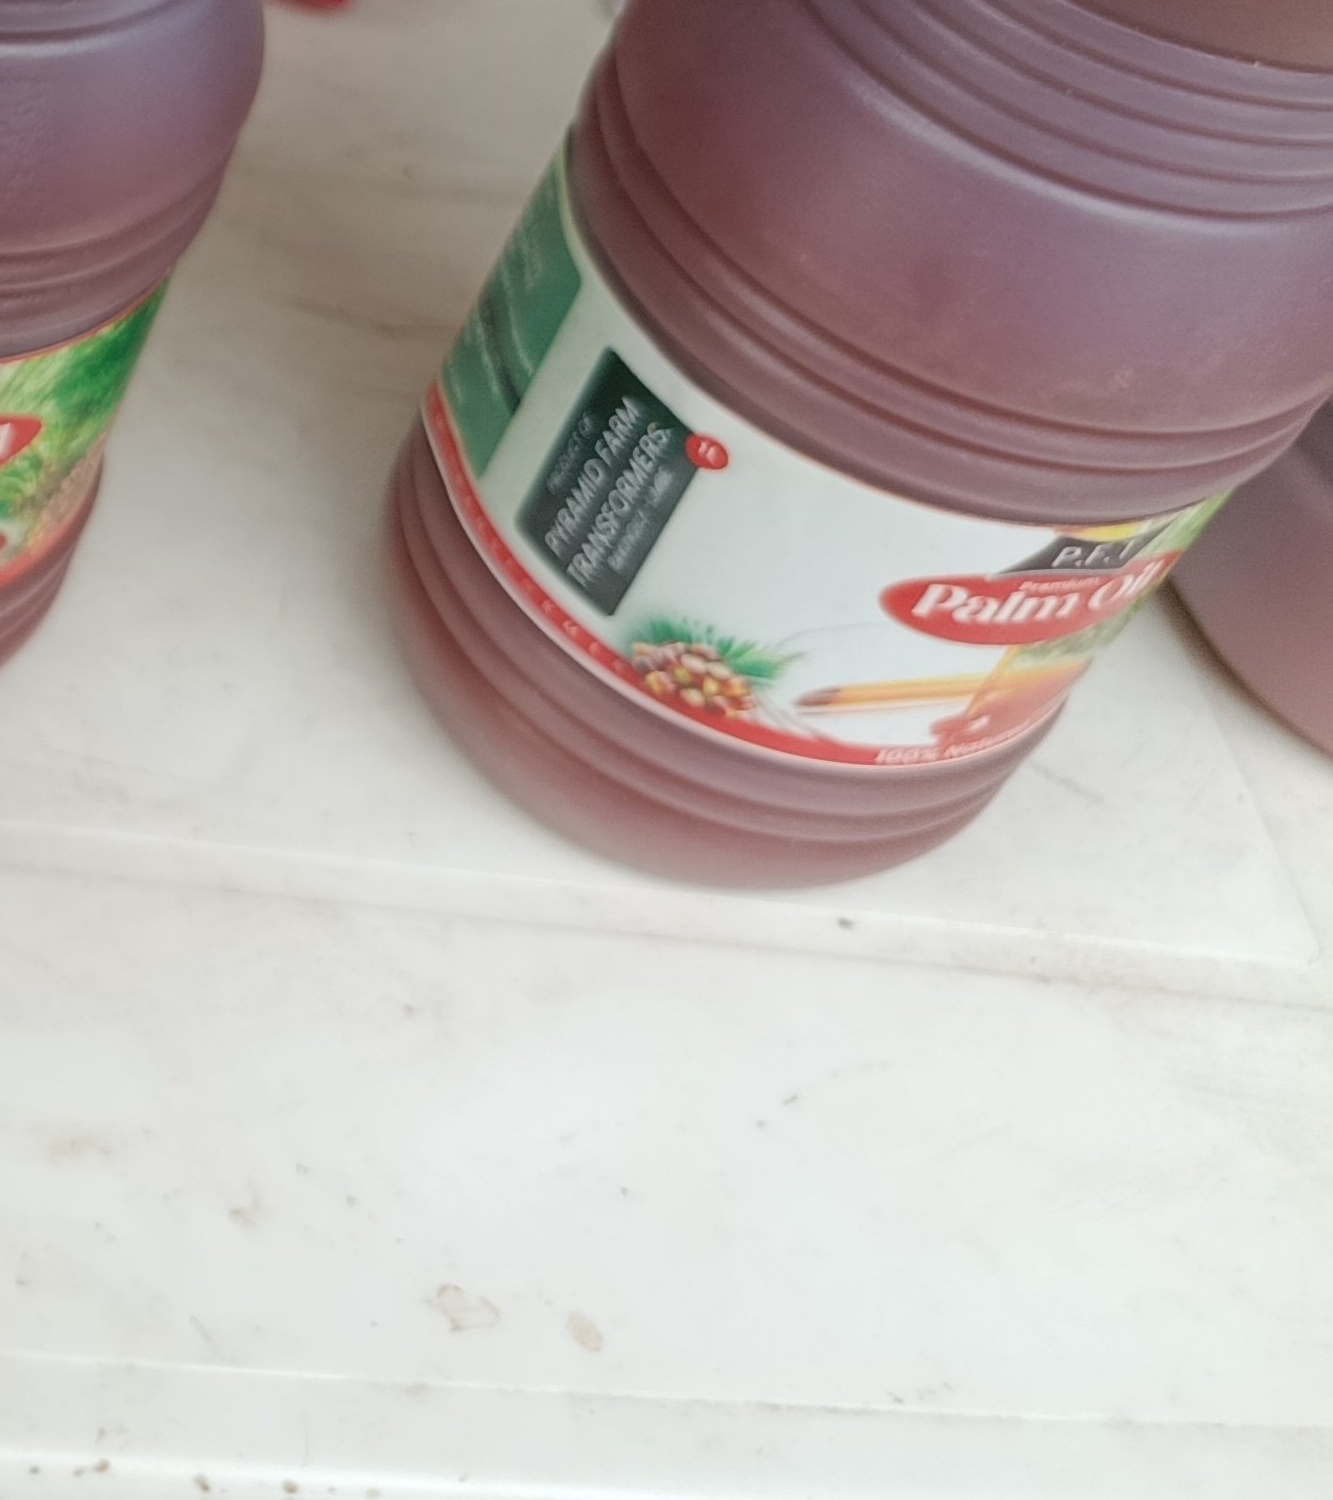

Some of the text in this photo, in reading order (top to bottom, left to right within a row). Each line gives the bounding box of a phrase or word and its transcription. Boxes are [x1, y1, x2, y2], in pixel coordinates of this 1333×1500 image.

[544, 457, 604, 558] PYRAMID
[594, 396, 643, 467] FARM
[911, 558, 1166, 625] Palm Oil
[1017, 576, 1101, 592] Premium
